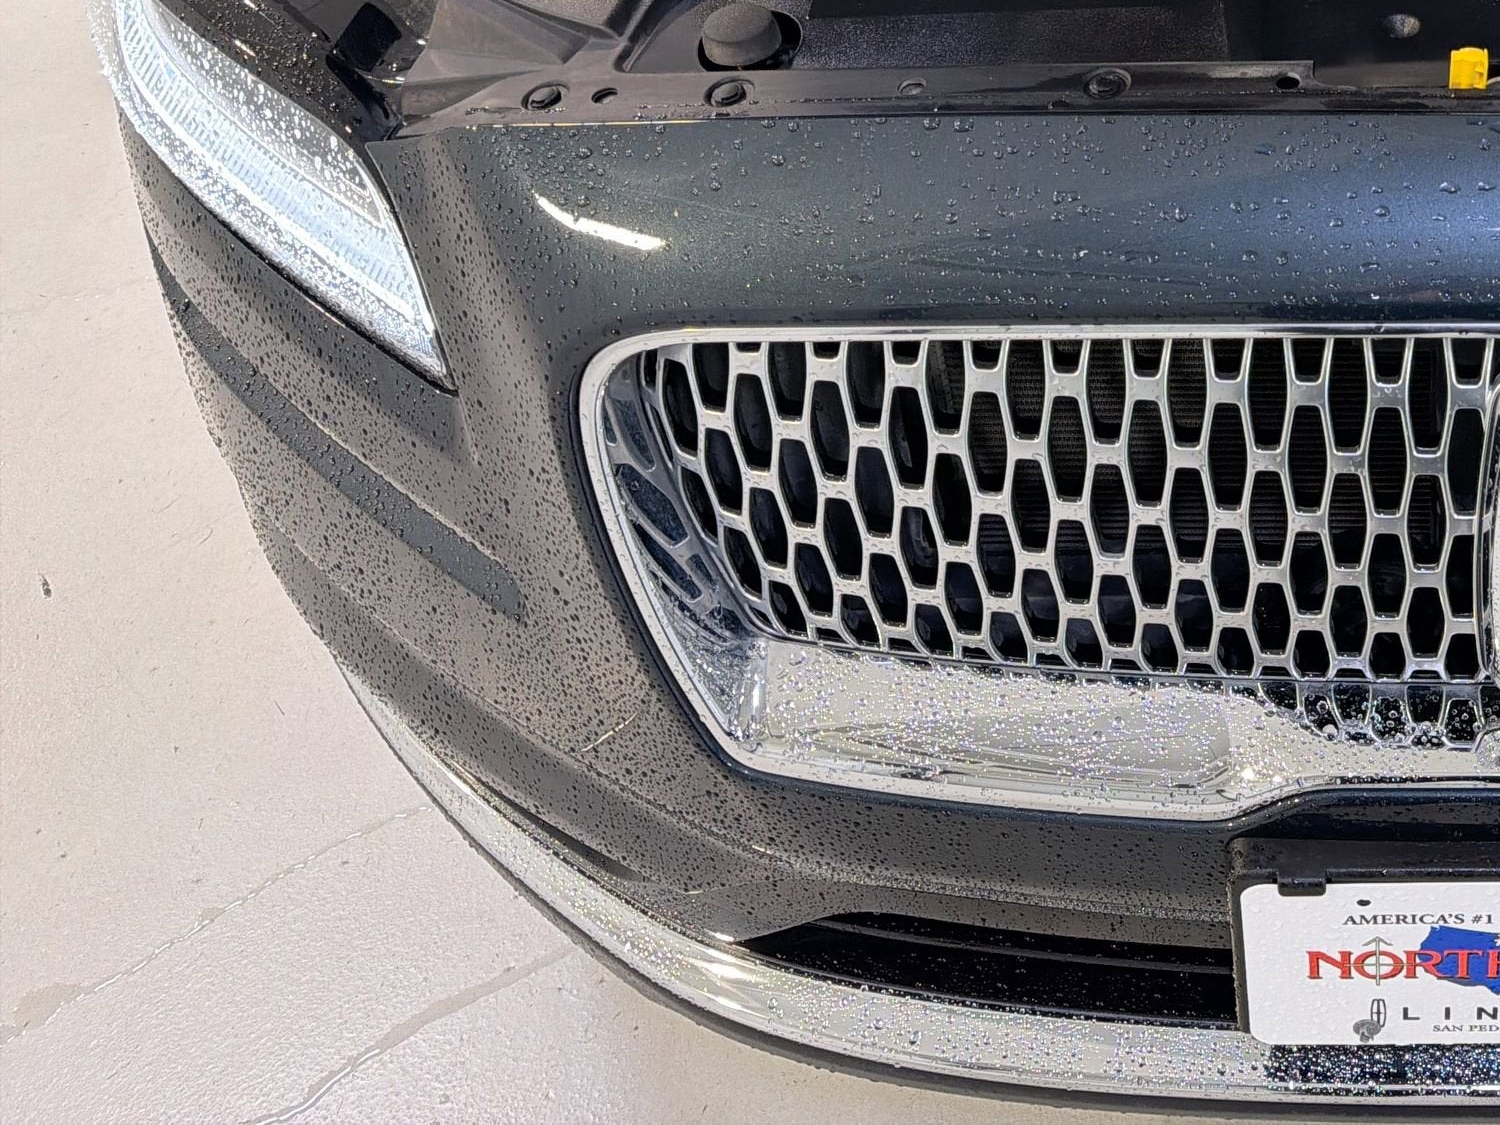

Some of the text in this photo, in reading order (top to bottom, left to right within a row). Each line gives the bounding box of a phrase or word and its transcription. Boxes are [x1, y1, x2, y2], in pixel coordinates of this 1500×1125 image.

[1342, 913, 1465, 925] AMERICA'S
[1471, 913, 1494, 924] #1
[1432, 1024, 1463, 1032] SAN
